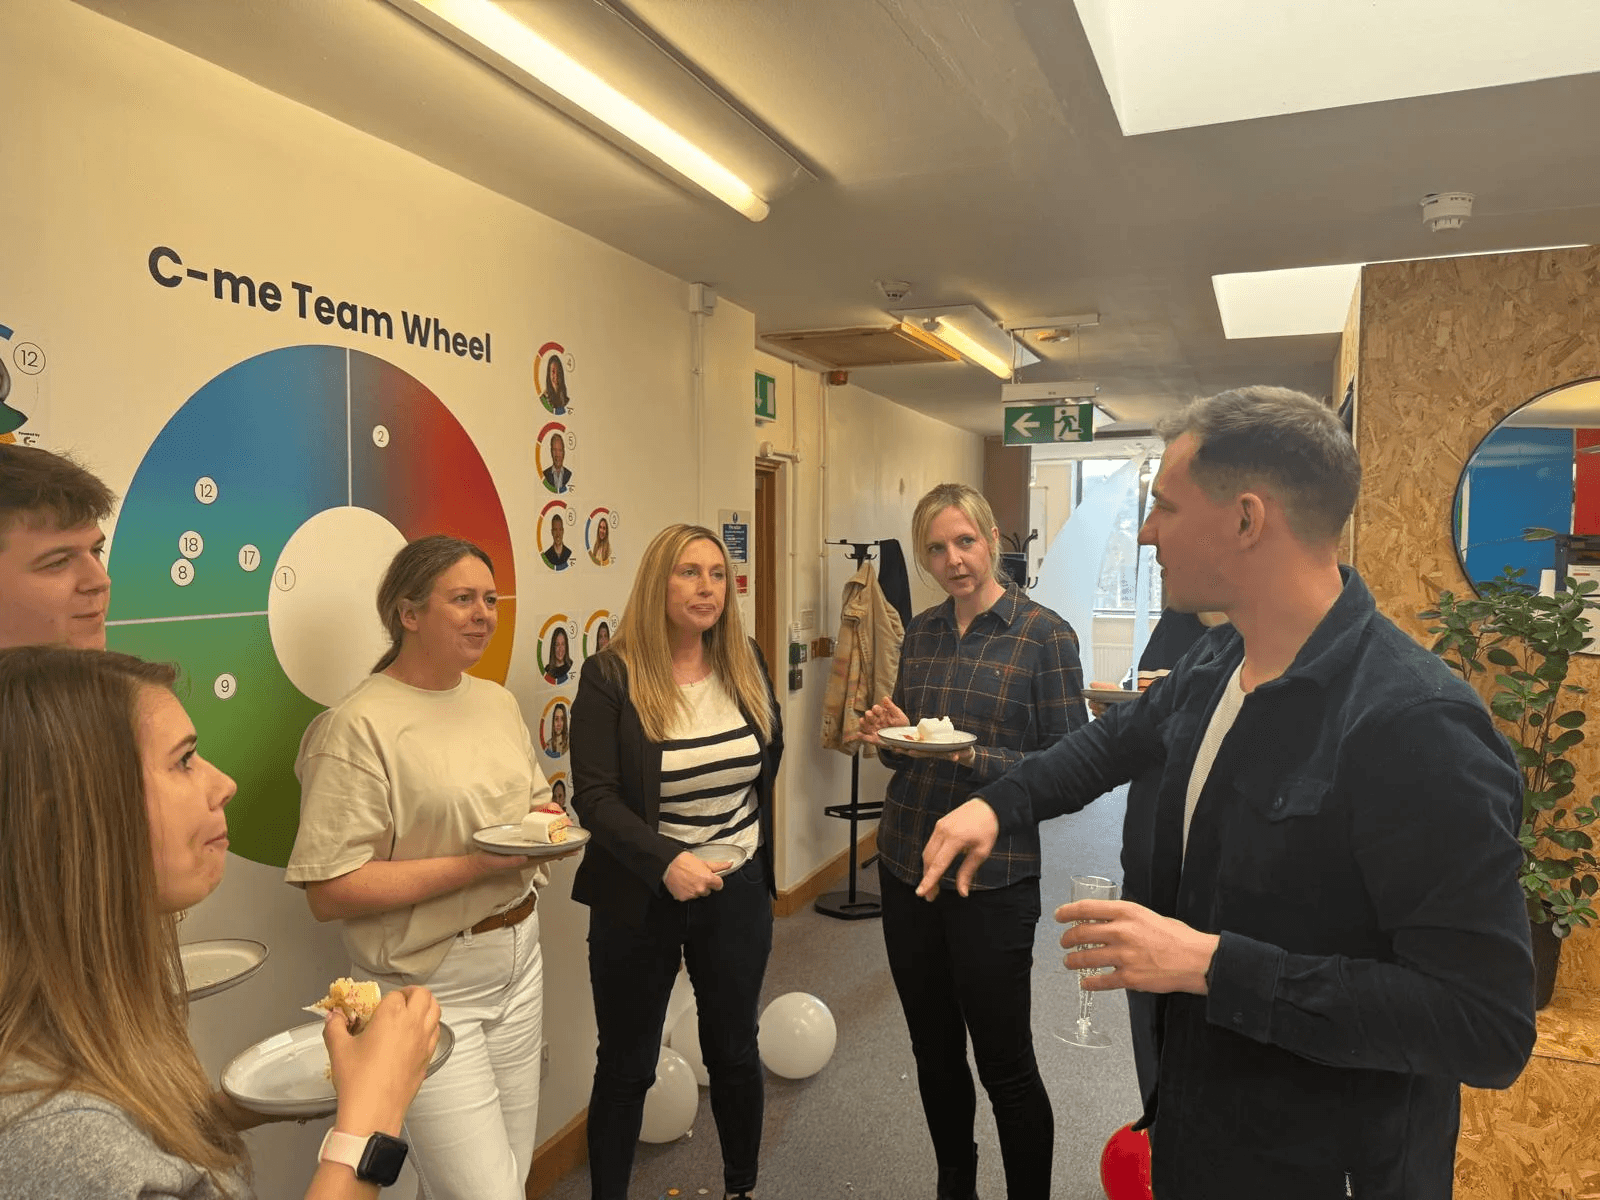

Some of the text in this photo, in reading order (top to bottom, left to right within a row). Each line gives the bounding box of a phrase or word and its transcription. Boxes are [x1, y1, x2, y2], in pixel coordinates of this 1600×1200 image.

[148, 246, 491, 363] C-me Team Wheel
[21, 349, 38, 367] 12
[199, 483, 213, 498] 12
[184, 537, 198, 552] 18
[243, 550, 256, 565] 17
[178, 565, 188, 580] 8
[221, 679, 230, 693] 9
